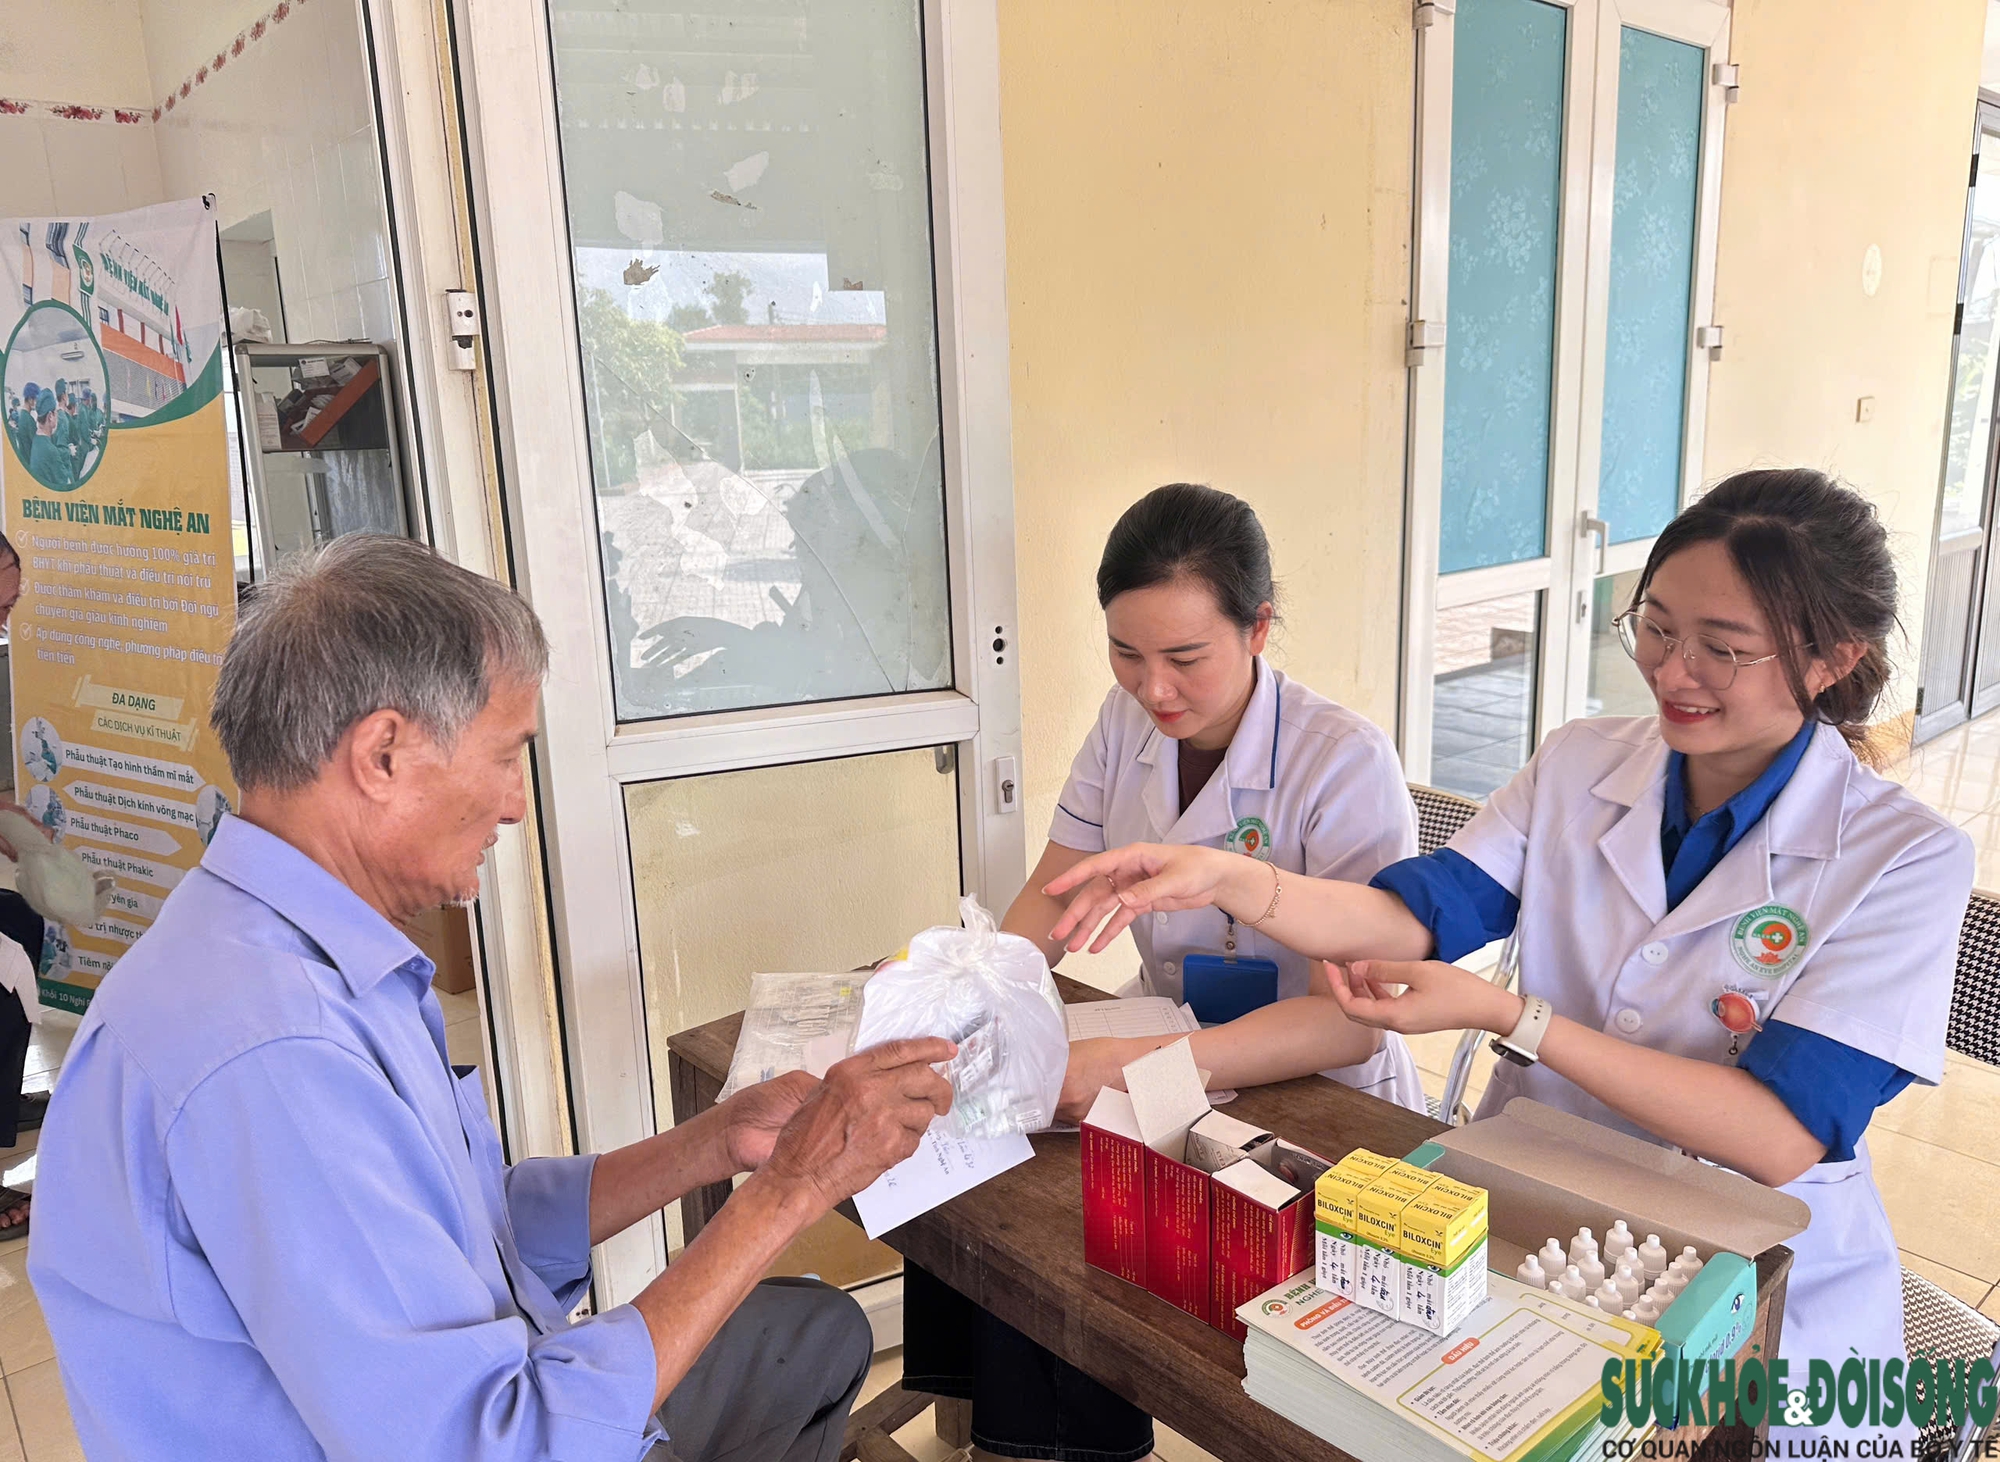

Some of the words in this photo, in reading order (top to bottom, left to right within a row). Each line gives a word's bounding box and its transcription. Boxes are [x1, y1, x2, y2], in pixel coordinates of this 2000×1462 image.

[22, 496, 62, 522] BỆNH
[65, 499, 99, 527] VIỆN
[102, 498, 136, 527] MẮT
[139, 506, 182, 535] NGHỆ
[186, 512, 210, 534] AN
[152, 547, 180, 562] 100%
[32, 556, 55, 569] BHYT
[57, 559, 72, 572] khi
[112, 692, 125, 705] ĐA
[128, 695, 156, 711] DẠNG
[97, 716, 114, 729] CÁC
[114, 720, 133, 733] DỊCH
[134, 724, 146, 736] VỤ
[155, 728, 181, 743] THUẬT
[65, 748, 85, 762] Phẫu
[86, 753, 107, 768] thuật
[108, 758, 123, 771] Tạo
[125, 761, 142, 774] hình
[178, 770, 194, 784] mắt
[74, 786, 93, 799] Phẫu
[95, 792, 116, 807] thuật
[118, 796, 136, 809] Dịch
[177, 811, 194, 824] mạc
[70, 817, 89, 830] Phẫu
[91, 822, 112, 837] thuật
[114, 826, 139, 841] Phaco
[82, 852, 101, 865] Phẫu
[103, 857, 126, 872] thuật
[127, 862, 154, 878] Phakic
[78, 956, 100, 969] Tiêm
[1350, 1155, 1386, 1170] BILOXCIN
[1327, 1173, 1364, 1189] BILOXCIN
[1392, 1169, 1429, 1185] BILOXCIN
[1370, 1186, 1407, 1203] BILOXCIN
[1434, 1185, 1473, 1201] BILOXCIN
[1317, 1198, 1353, 1218] BILOXCIN
[1413, 1203, 1453, 1220] BILOXCIN
[1343, 1216, 1354, 1224] Eye
[1359, 1212, 1395, 1232] BILOXCIN
[1384, 1230, 1396, 1238] Eye
[1403, 1229, 1441, 1250] BILOXCIN
[1431, 1247, 1442, 1256] Eye
